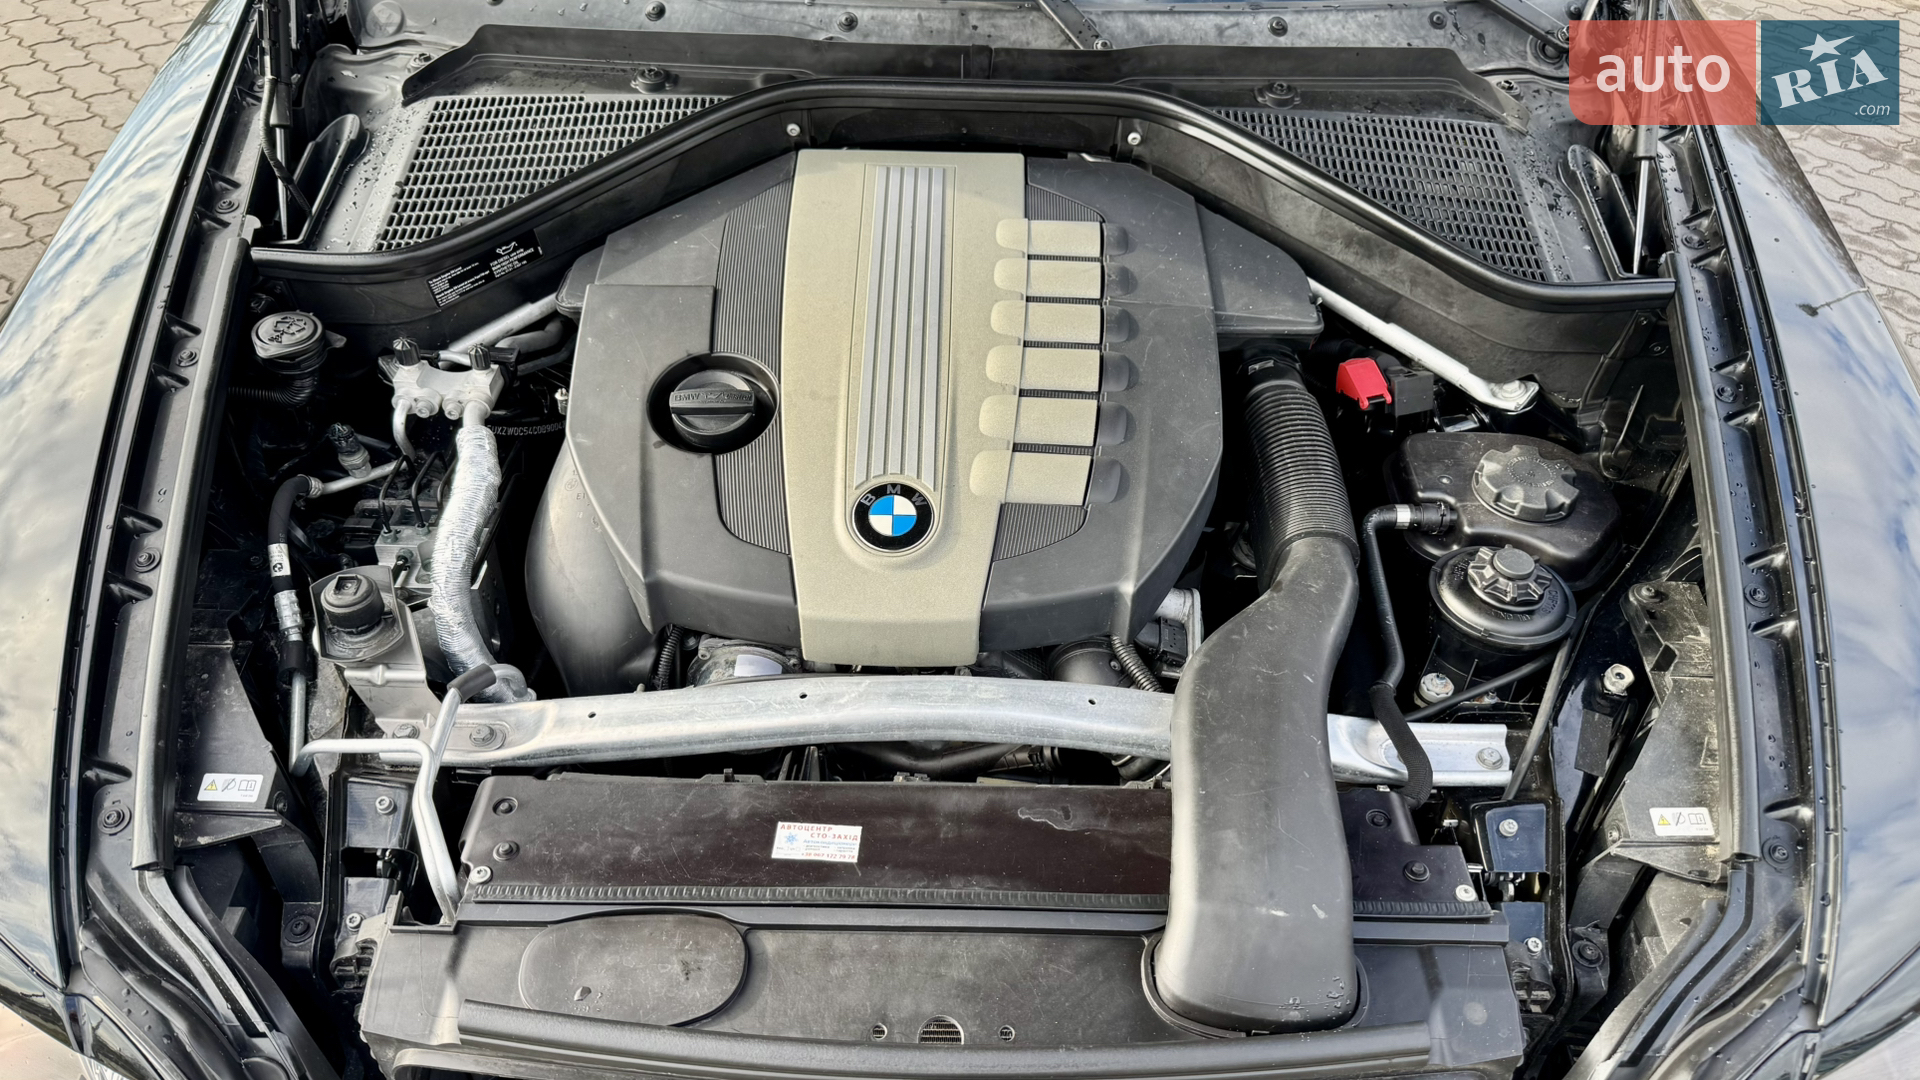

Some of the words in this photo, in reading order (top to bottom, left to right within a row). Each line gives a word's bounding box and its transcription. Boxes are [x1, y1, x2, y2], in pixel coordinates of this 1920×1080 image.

[674, 393, 700, 402] BMW
[860, 484, 927, 506] BMW
[780, 824, 833, 832] АВТОЦЕНТР
[810, 833, 859, 841] СТО-ЗАХІД
